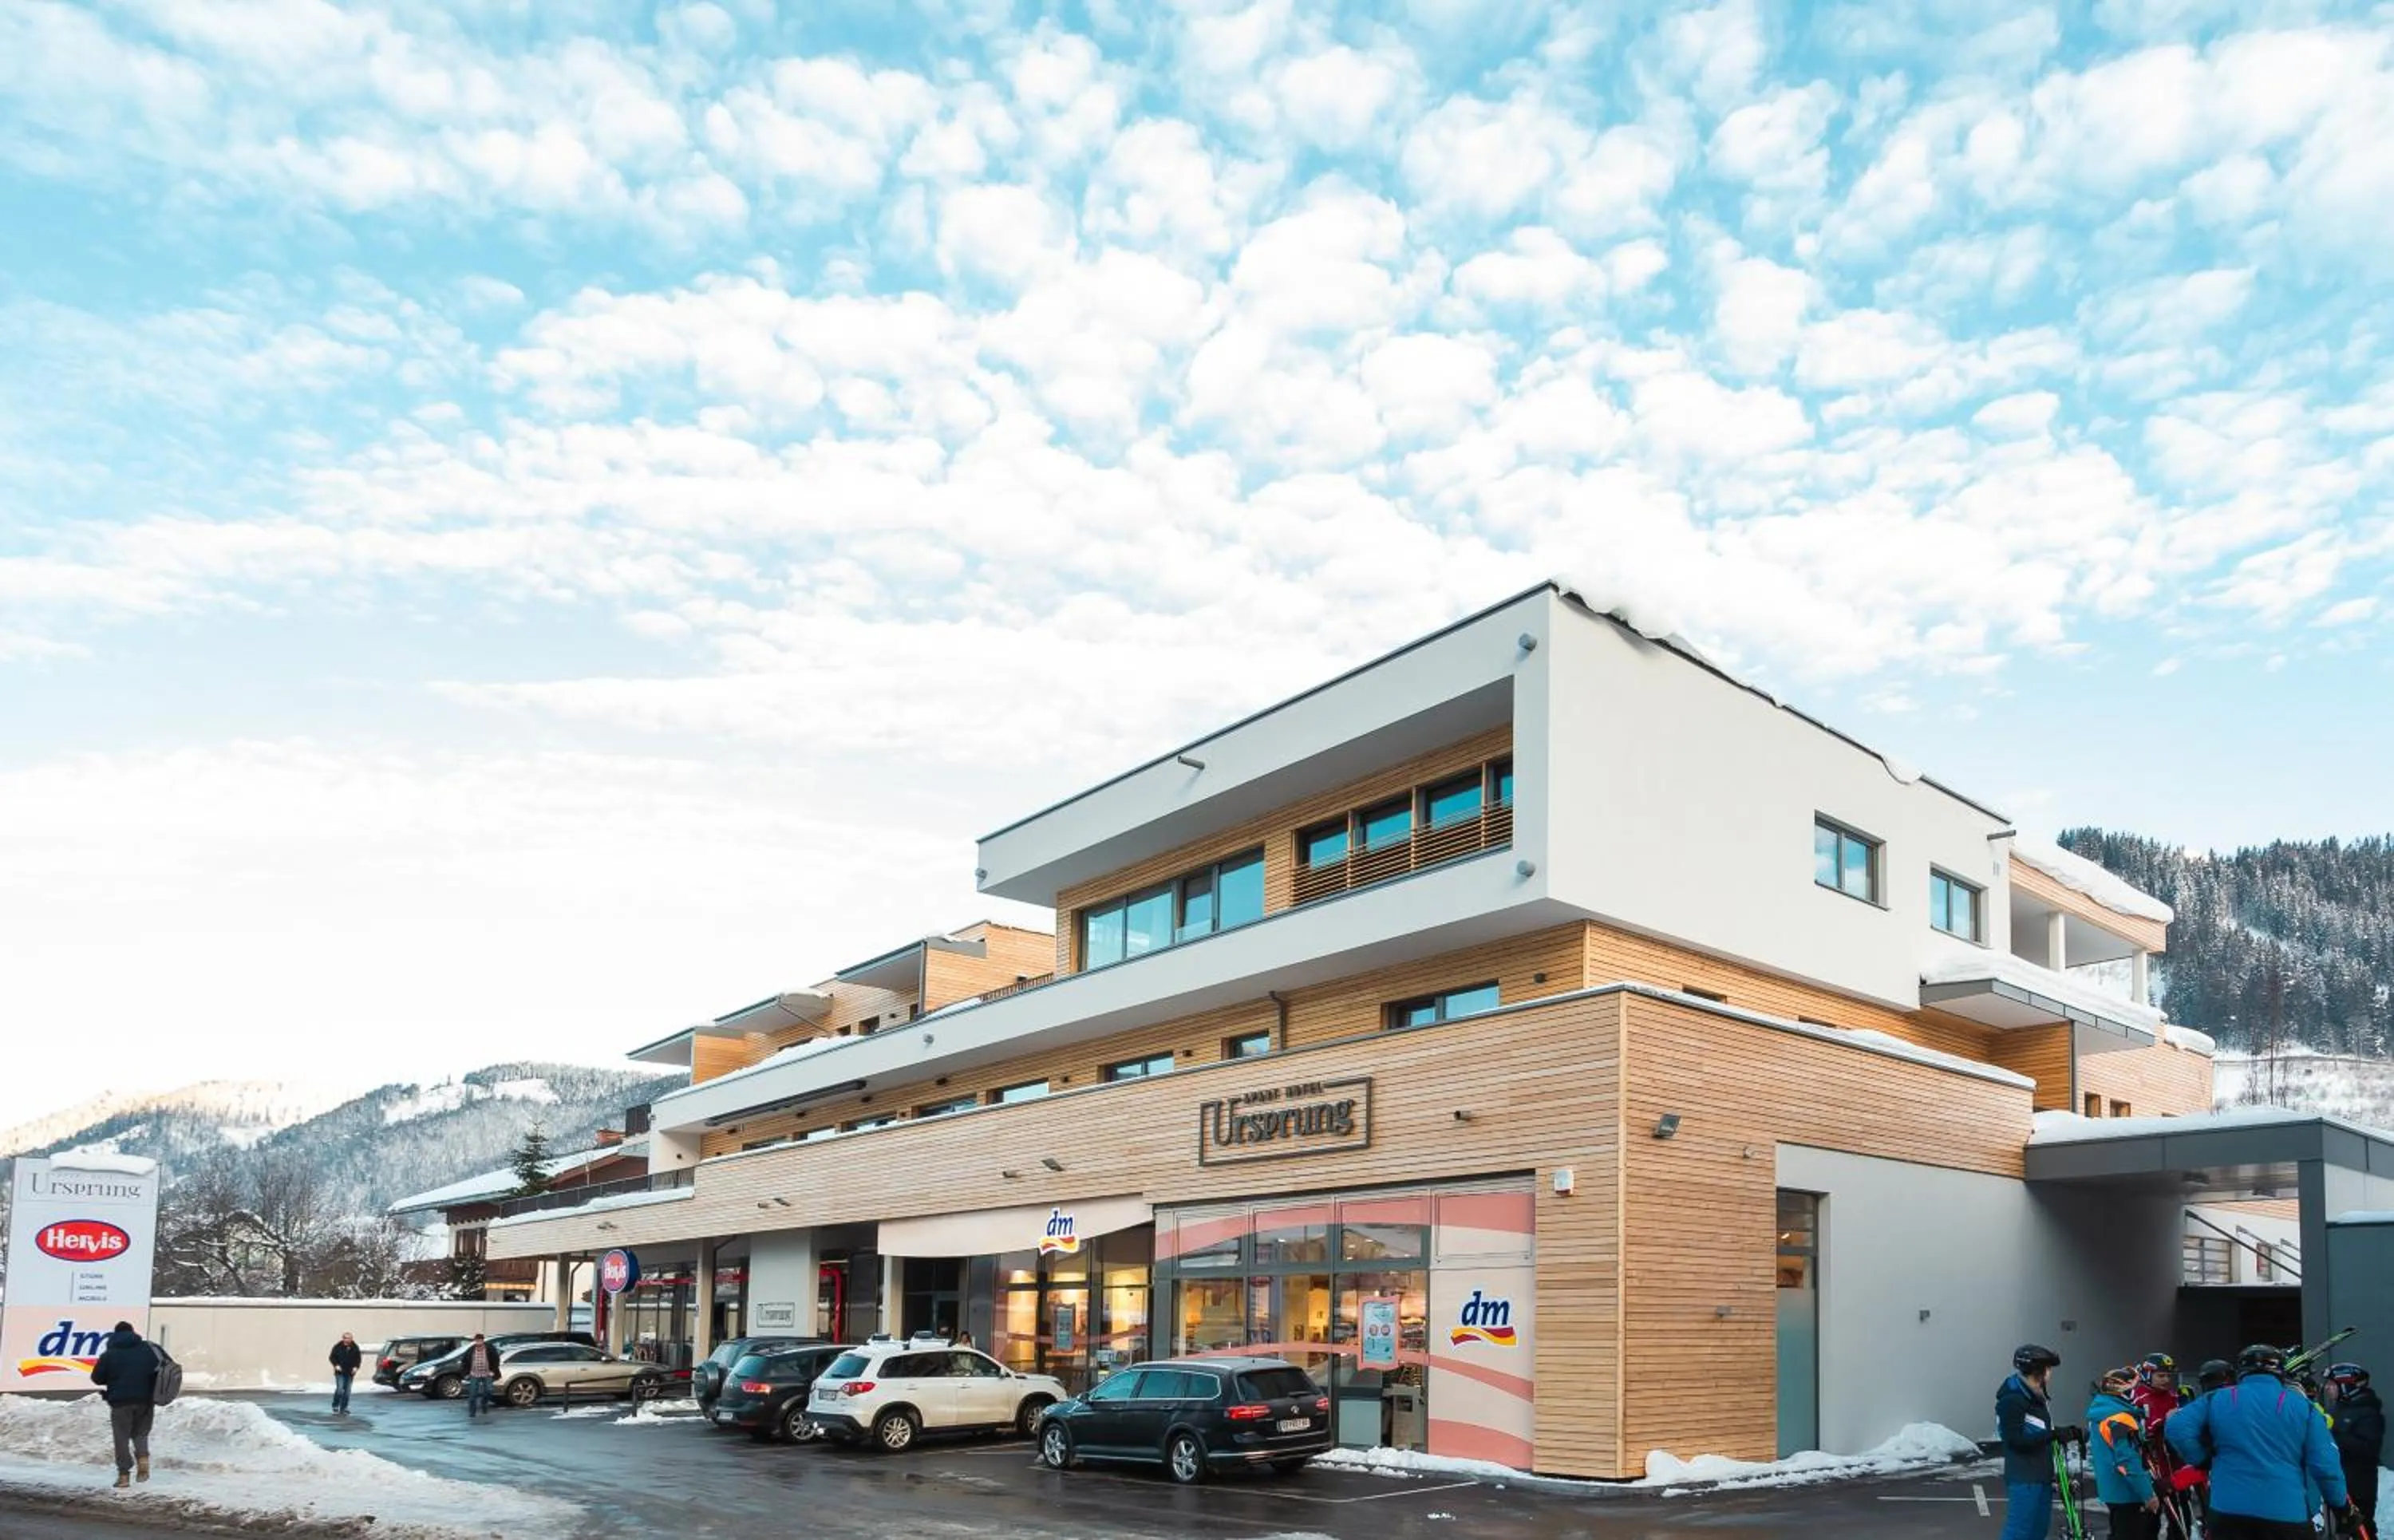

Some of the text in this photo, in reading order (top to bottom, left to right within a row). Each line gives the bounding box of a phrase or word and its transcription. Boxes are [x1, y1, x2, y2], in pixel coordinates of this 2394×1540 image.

[1212, 1098, 1356, 1146] Ursprung
[30, 1172, 142, 1198] Ursprung
[1046, 1210, 1073, 1236] dm
[46, 1228, 124, 1254] Hervis
[1461, 1290, 1510, 1326] dm
[38, 1321, 112, 1357] dm
